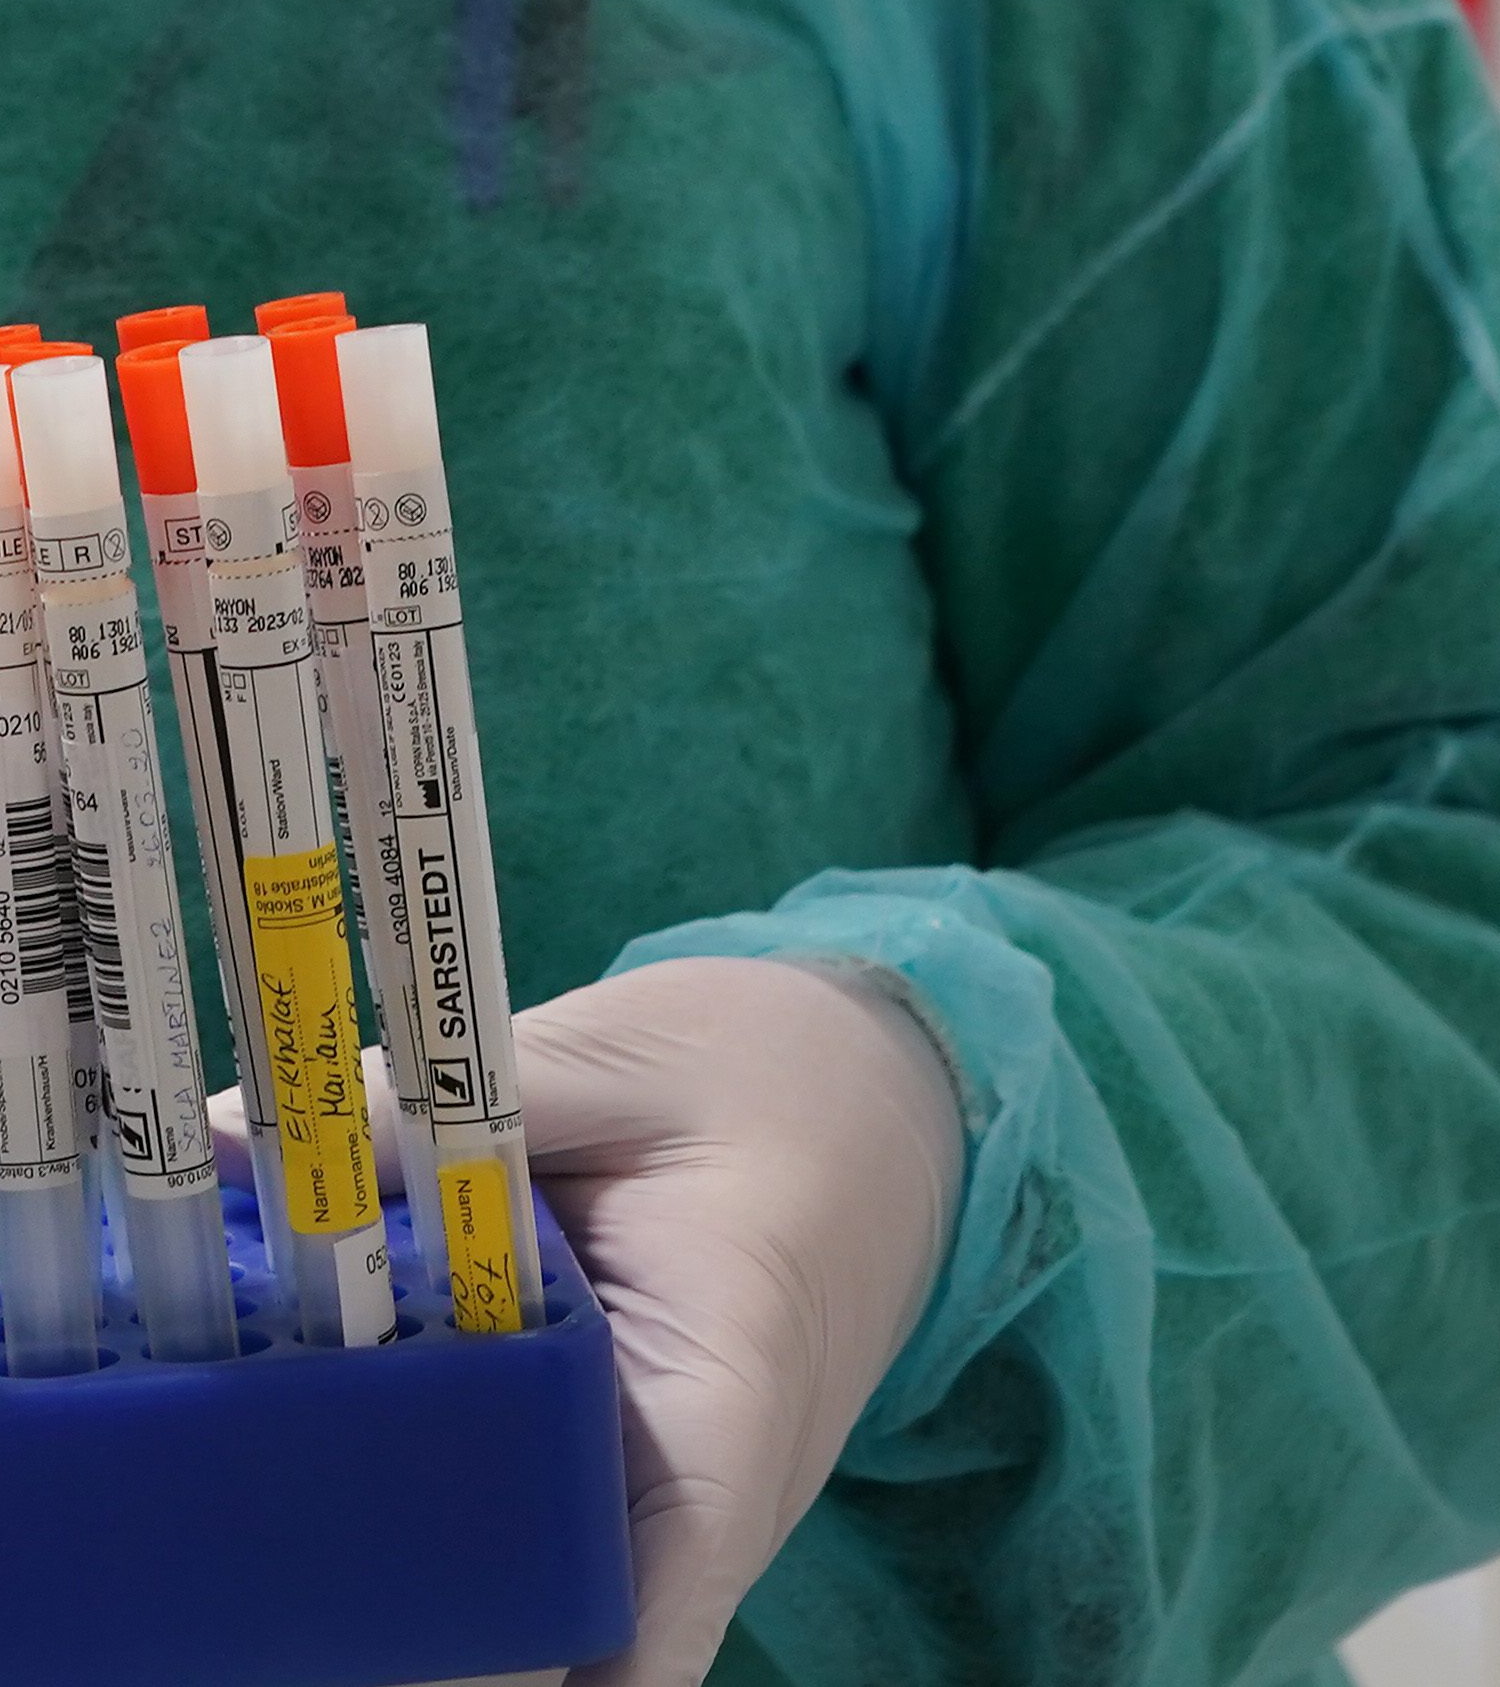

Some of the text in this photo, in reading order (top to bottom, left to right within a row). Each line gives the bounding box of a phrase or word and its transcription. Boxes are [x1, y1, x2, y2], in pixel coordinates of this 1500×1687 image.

[73, 545, 91, 564] R
[214, 597, 255, 617] RAYON
[386, 608, 418, 625] LOT
[445, 726, 463, 802] Datum/Date
[255, 898, 304, 915] Skoblo
[418, 847, 467, 1040] SARSTEDT
[309, 1163, 330, 1224] Name:
[456, 1178, 476, 1241] Name:
